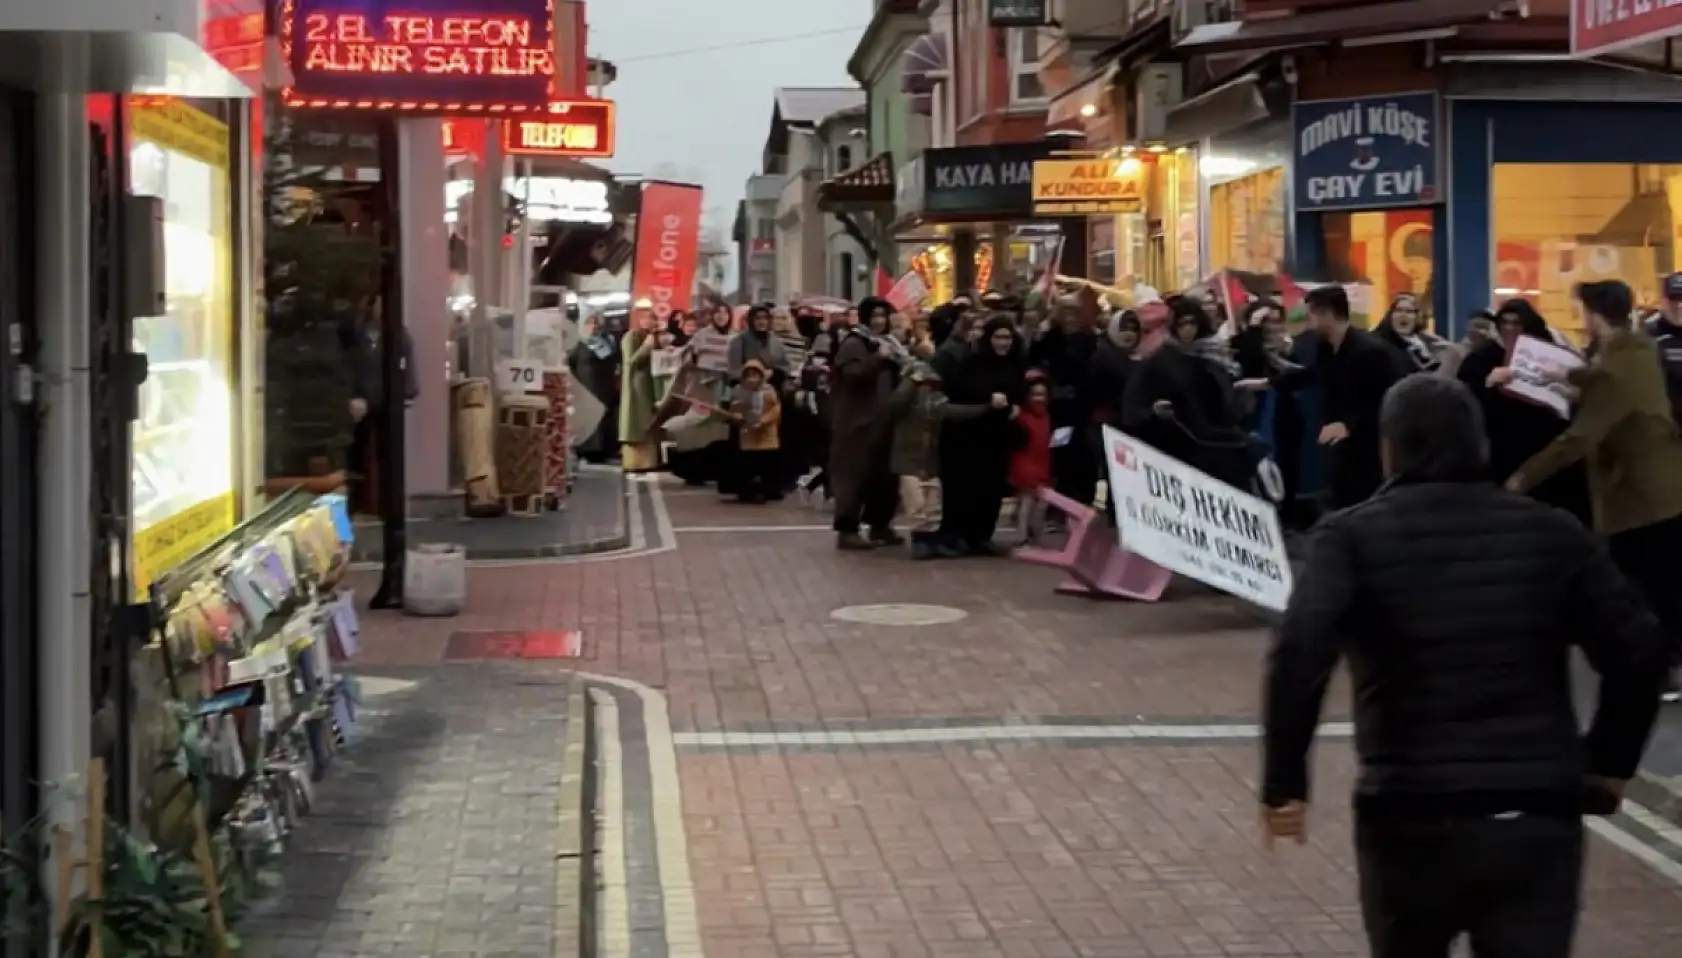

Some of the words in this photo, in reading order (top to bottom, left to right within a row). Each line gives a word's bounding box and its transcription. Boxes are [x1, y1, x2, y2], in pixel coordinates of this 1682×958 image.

[306, 14, 374, 42] 2.EL
[386, 16, 530, 46] TELEFON
[306, 43, 412, 73] ALINIR
[424, 46, 554, 75] SATILIR
[1302, 102, 1362, 156] MAVİ
[1368, 102, 1430, 147] KÖŞE
[935, 165, 995, 187] KAYA
[1040, 182, 1138, 197] KUNDURA
[1308, 173, 1365, 204] ÇAY
[1375, 164, 1424, 196] EVİ
[652, 213, 682, 331] odfone
[508, 366, 535, 384] 70
